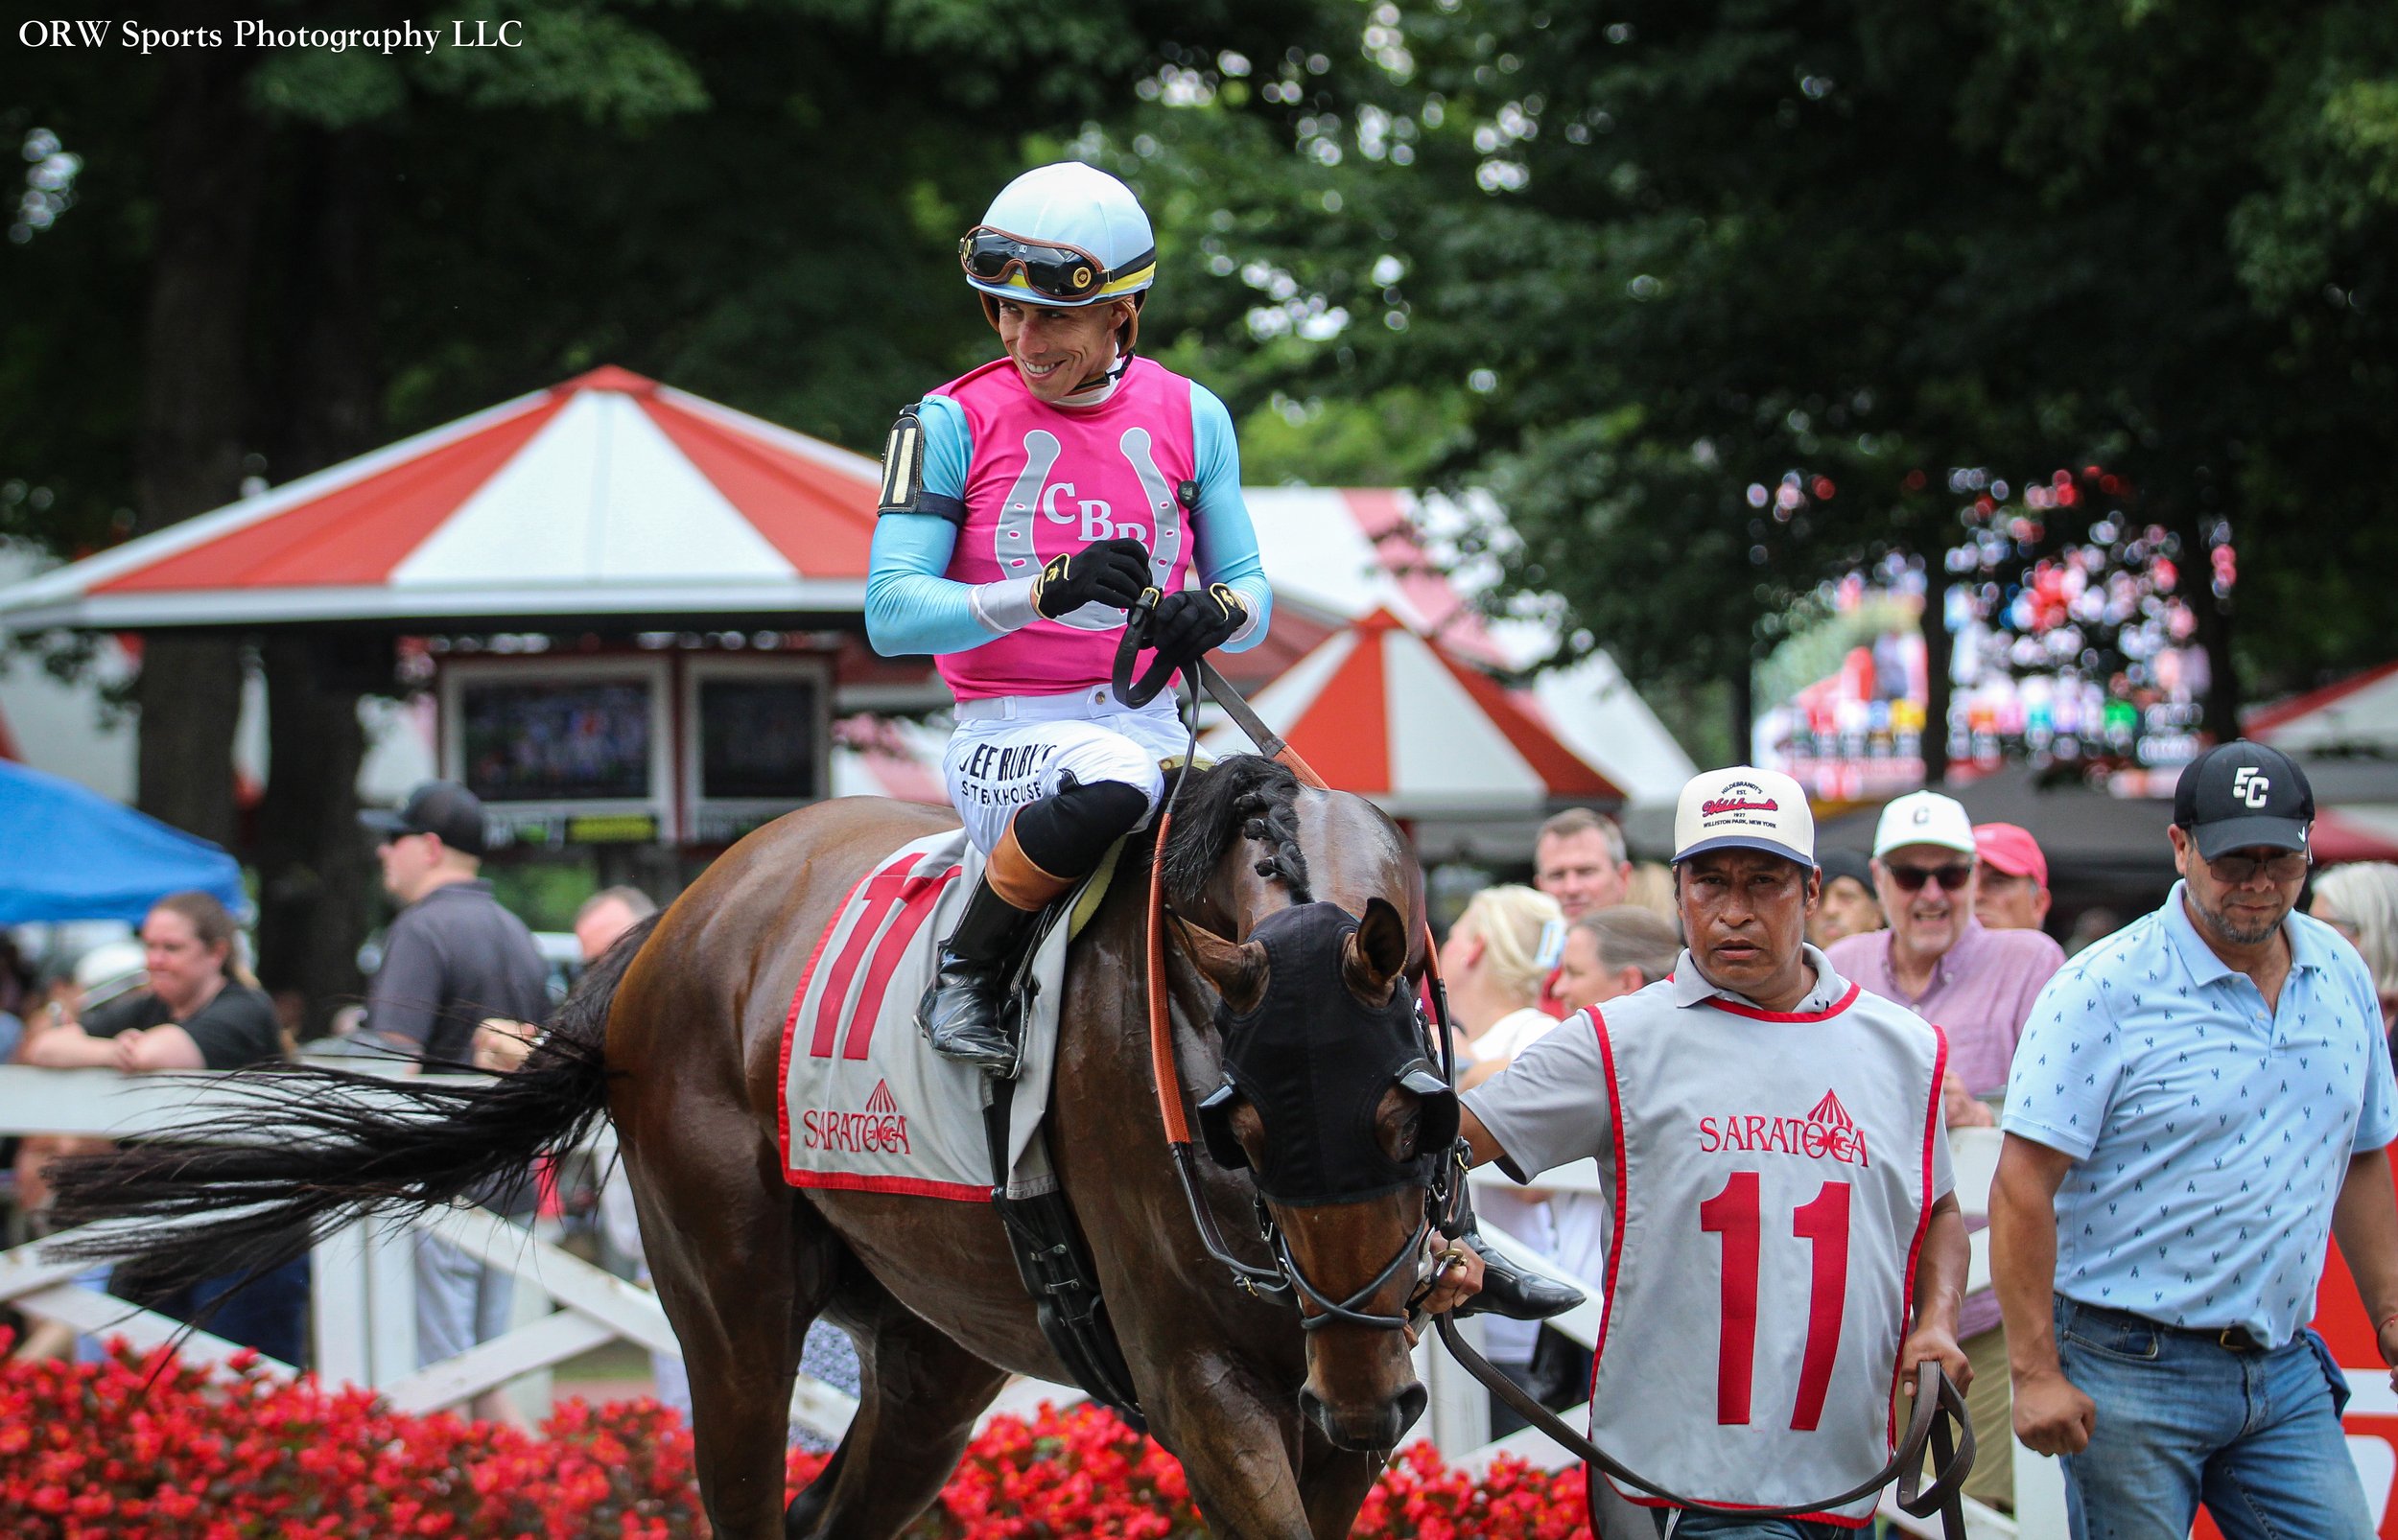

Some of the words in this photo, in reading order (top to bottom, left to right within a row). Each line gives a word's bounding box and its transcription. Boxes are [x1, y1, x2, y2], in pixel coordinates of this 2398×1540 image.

[1721, 781, 1763, 795] HILDEBRANDT'S
[1703, 819, 1730, 828] WILLISTON
[810, 852, 963, 1062] 11
[804, 1108, 911, 1155] SARATOGA
[1699, 1114, 1869, 1168] SARATOGA
[1700, 1171, 1851, 1432] 11
